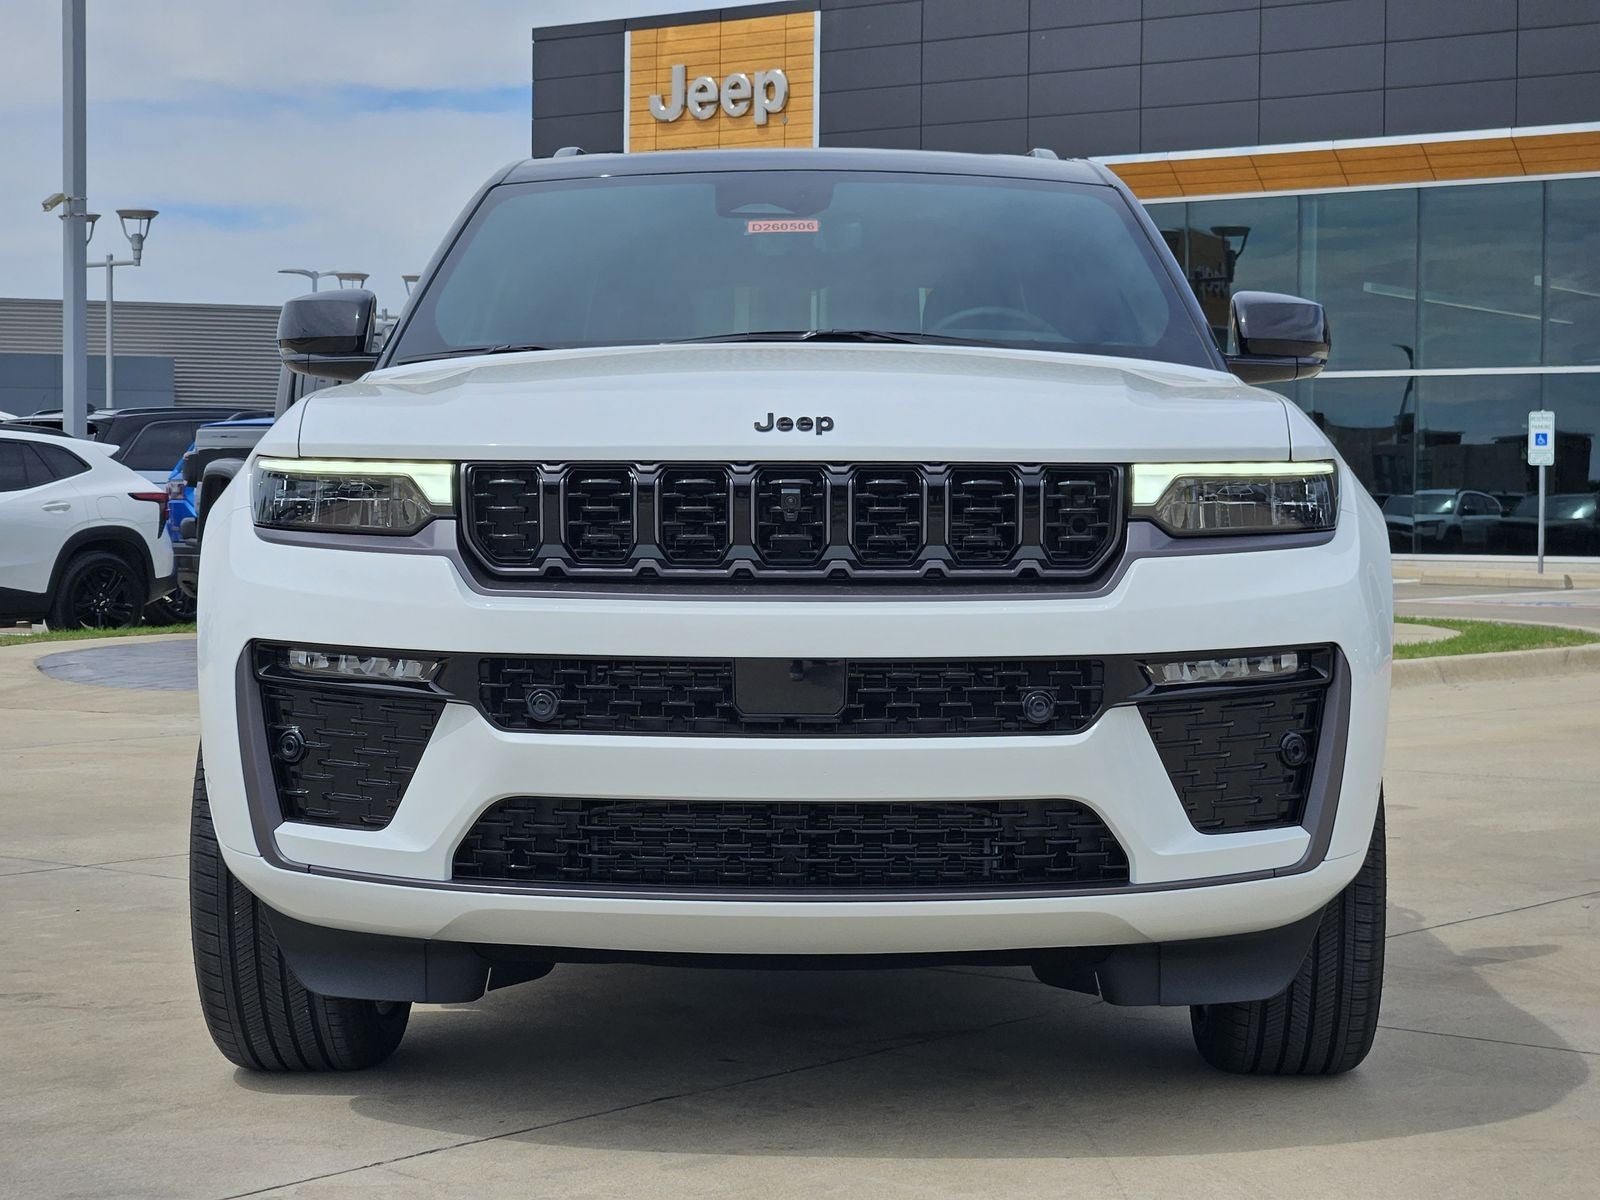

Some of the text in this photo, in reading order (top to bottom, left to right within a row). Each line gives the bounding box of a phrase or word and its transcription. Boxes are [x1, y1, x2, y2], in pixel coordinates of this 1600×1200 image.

[648, 63, 788, 126] Jeep
[751, 222, 816, 232] D260506
[753, 412, 835, 436] Jeep
